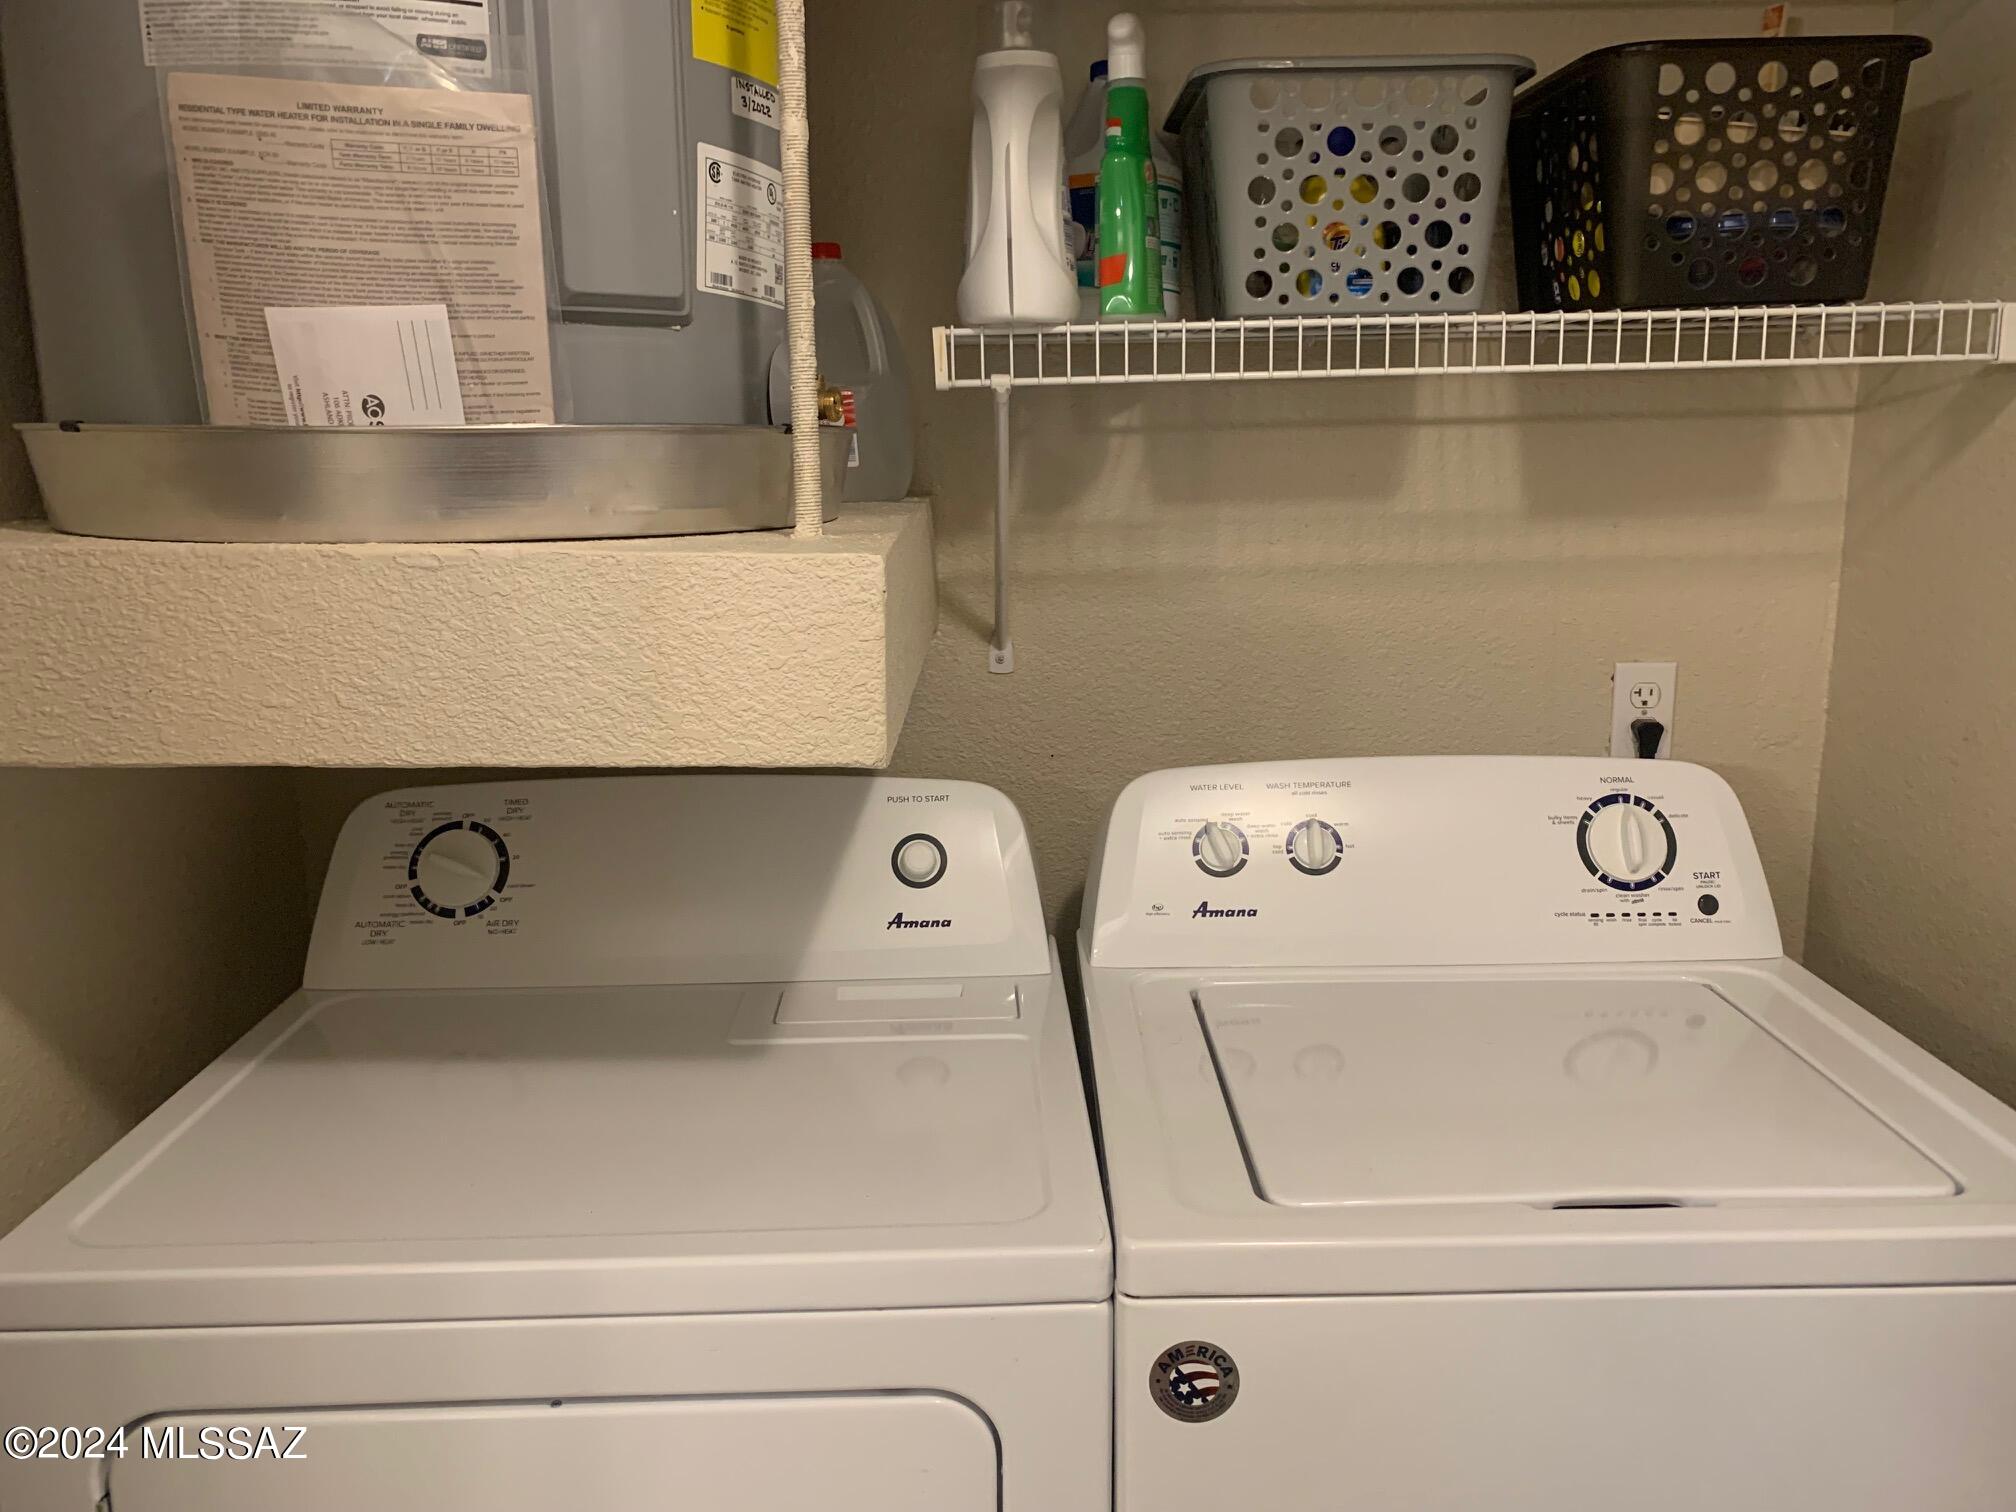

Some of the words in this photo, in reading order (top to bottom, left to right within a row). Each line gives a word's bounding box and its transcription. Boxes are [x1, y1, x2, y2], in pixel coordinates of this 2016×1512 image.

[736, 78, 776, 103] INSTALLED
[296, 101, 331, 112] LIMITED
[333, 104, 384, 116] WARRANTY
[741, 96, 772, 118] 3/2022
[178, 103, 225, 115] RESIDENTIAL
[226, 106, 247, 117] TYPE
[248, 109, 276, 119] WATER
[277, 111, 309, 121] HEATER
[311, 114, 329, 123] FOR
[330, 115, 391, 127] INSTALLATION
[401, 120, 409, 128] A
[410, 120, 443, 130] SINGLE
[444, 122, 475, 131] FAMILY
[321, 392, 334, 425] ASHLAND
[1265, 782, 1290, 790] WASH
[1293, 780, 1352, 789] TEMPERATURE
[1599, 776, 1635, 784] NORMAL
[1189, 783, 1218, 792] WATER
[1219, 783, 1244, 791] LEVEL
[503, 798, 529, 806] TIMED
[887, 795, 910, 803] PUSH
[912, 795, 923, 803] TO
[924, 794, 950, 803] START
[384, 800, 435, 810] AUTOMATIC
[399, 809, 417, 817] DRY
[1692, 871, 1721, 880] START
[1192, 901, 1258, 919] Amana
[355, 920, 407, 928] AUTOMATIC
[486, 919, 500, 927] AIR
[502, 919, 520, 927] DRY
[886, 912, 952, 930] Amana
[370, 929, 389, 937] DRY
[1158, 1345, 1233, 1379] AMERICA
